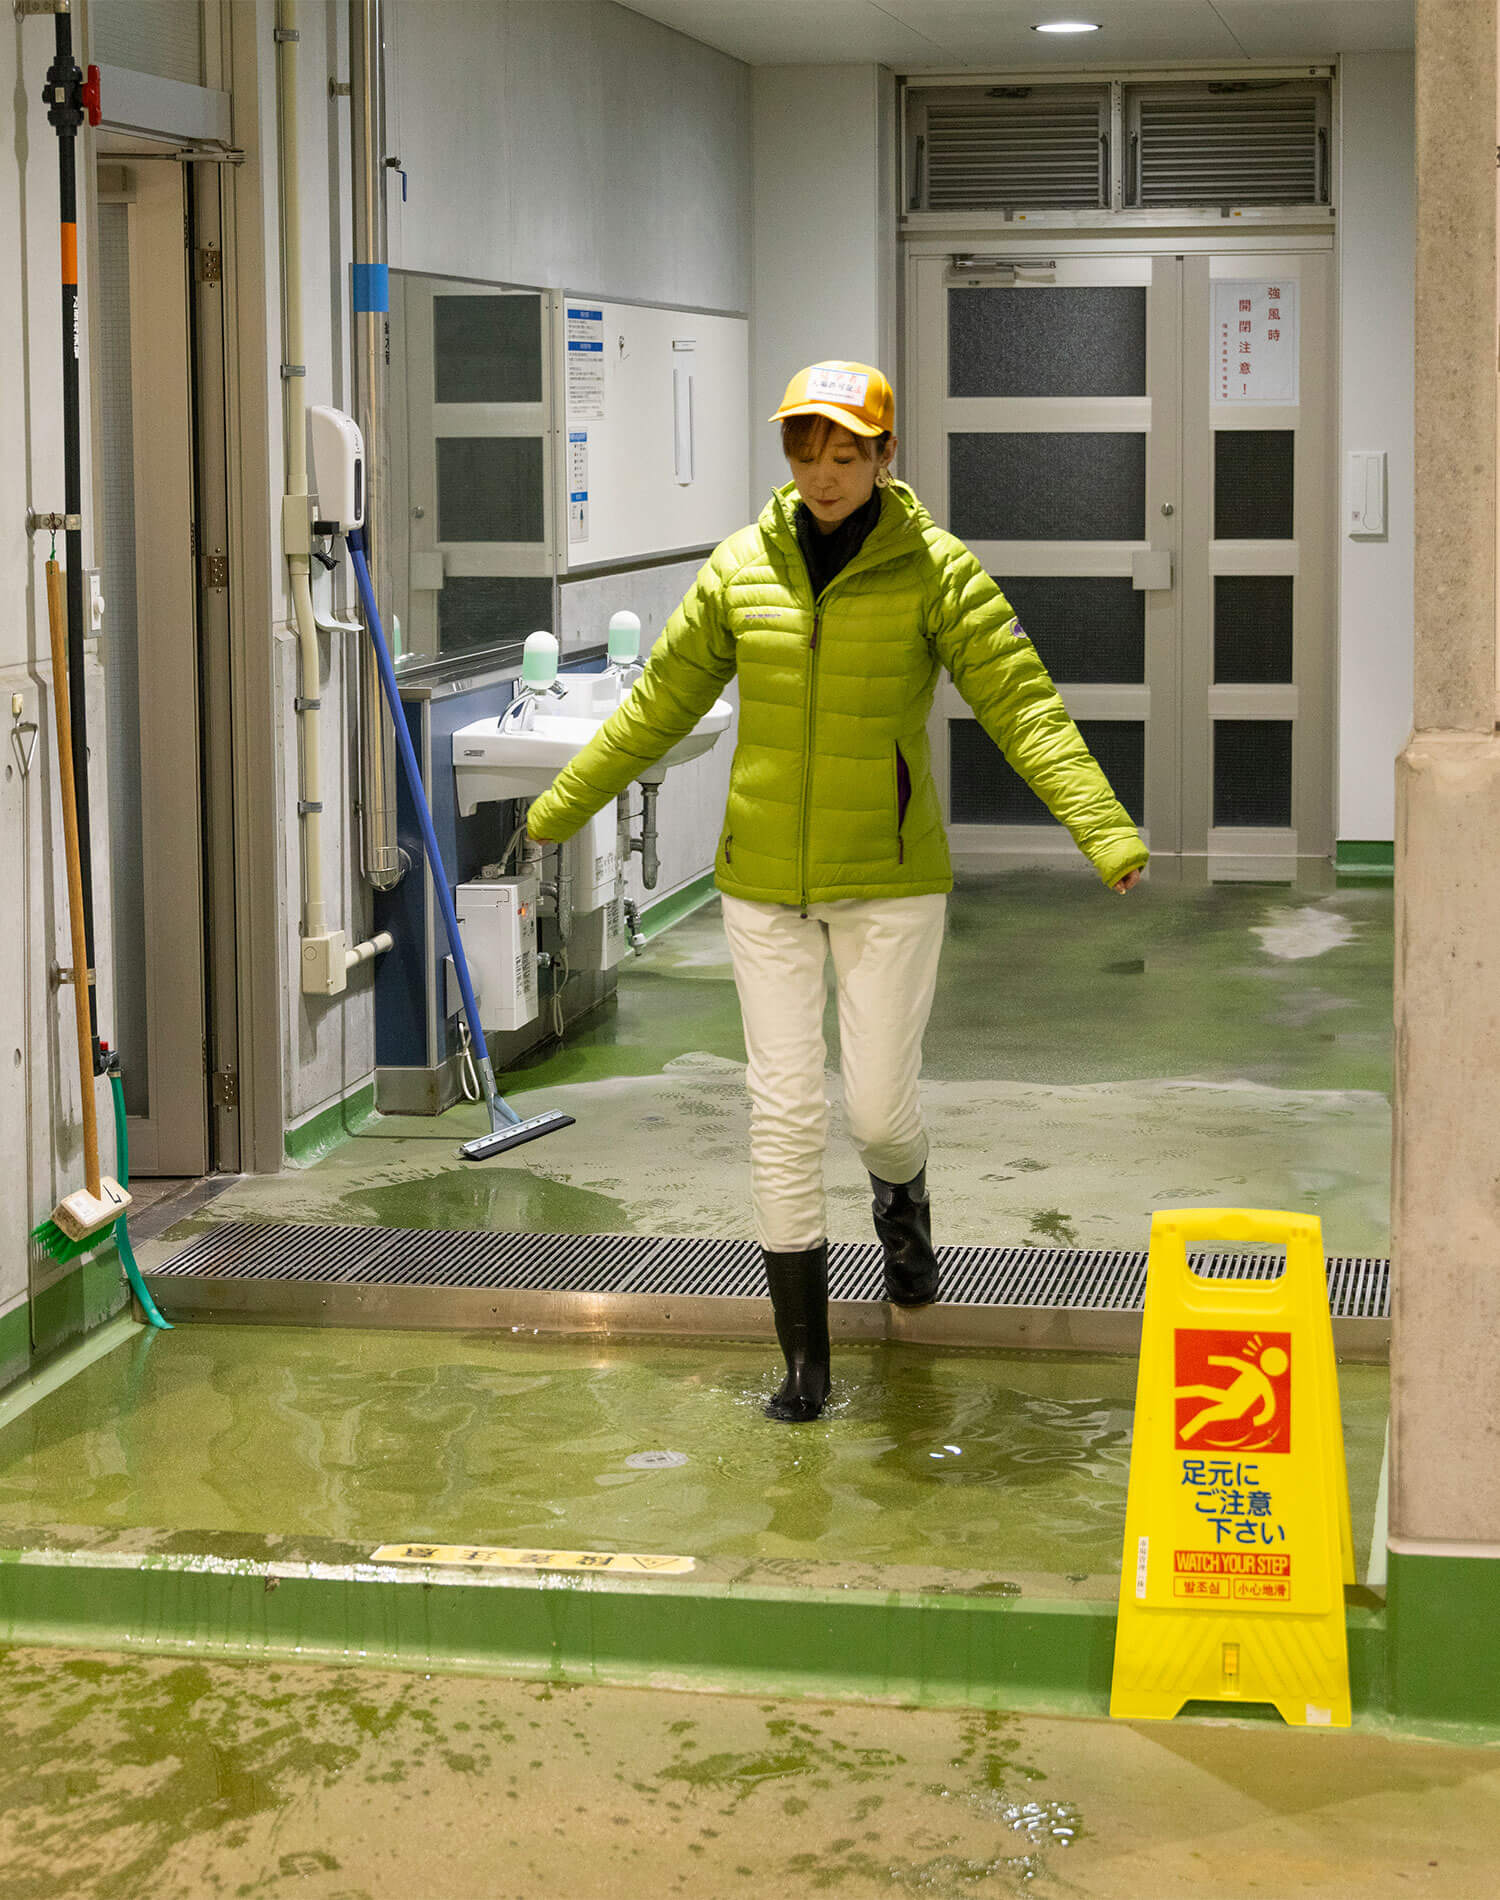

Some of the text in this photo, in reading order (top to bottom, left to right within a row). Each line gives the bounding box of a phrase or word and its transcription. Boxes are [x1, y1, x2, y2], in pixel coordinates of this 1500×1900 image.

[1268, 287, 1281, 341] 強風時
[1239, 299, 1252, 395] 開閉注意！
[1181, 1459, 1260, 1487] 足元に
[1194, 1488, 1272, 1517] ご注意
[1206, 1519, 1286, 1545] 下さい
[1176, 1551, 1289, 1575] WATCH YOUR STEP
[1238, 1583, 1288, 1597] 小心地滑
